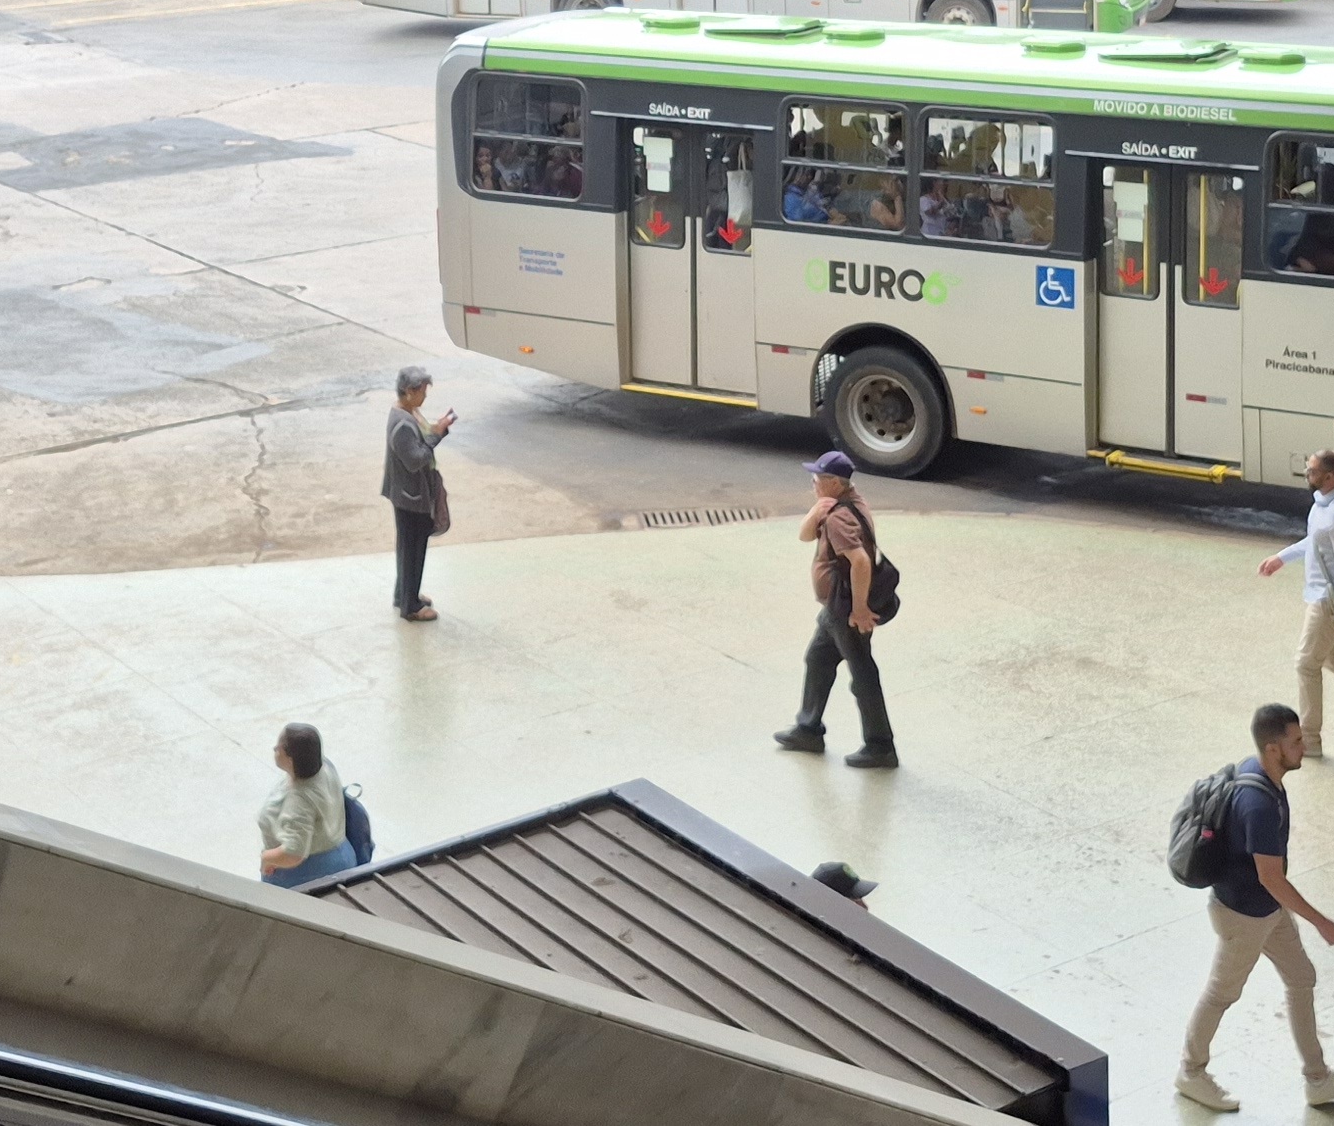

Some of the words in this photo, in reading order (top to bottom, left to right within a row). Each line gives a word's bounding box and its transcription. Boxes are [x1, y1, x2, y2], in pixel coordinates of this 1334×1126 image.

[648, 102, 680, 117] SAÍDA
[687, 106, 712, 120] EXIT
[1093, 99, 1147, 116] MOVIDO
[1150, 105, 1160, 117] A
[1163, 105, 1238, 122] BIODIESEL
[1121, 140, 1160, 157] SAÍDA
[1168, 145, 1198, 159] EXIT
[1282, 345, 1308, 360] Área
[1311, 350, 1317, 361] 1
